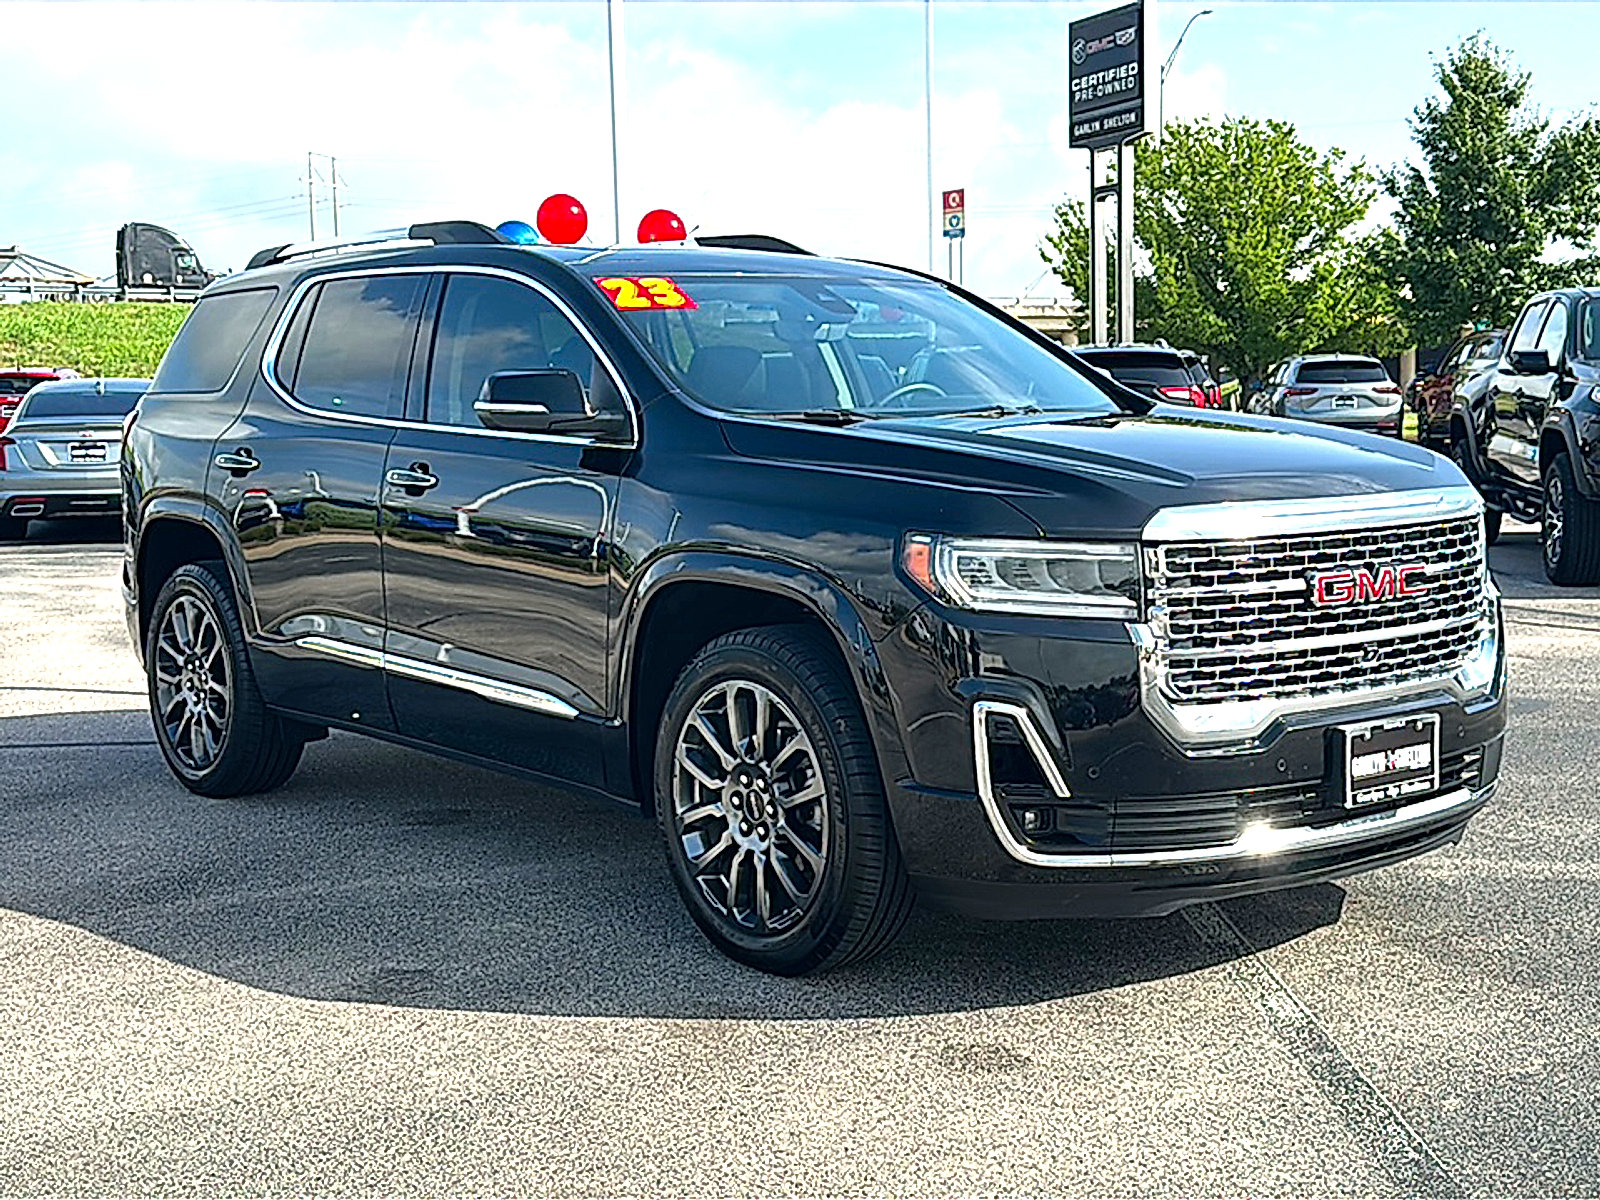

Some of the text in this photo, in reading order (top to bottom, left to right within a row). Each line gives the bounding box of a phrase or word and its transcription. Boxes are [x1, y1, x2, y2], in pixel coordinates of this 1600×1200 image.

[1086, 34, 1115, 55] GMC
[1071, 62, 1139, 92] CERTIFIED
[1074, 76, 1135, 103] PRE-OWNED
[1074, 111, 1136, 137] GARLYN SHELTON
[600, 277, 686, 308] 23
[1313, 564, 1428, 606] GMC
